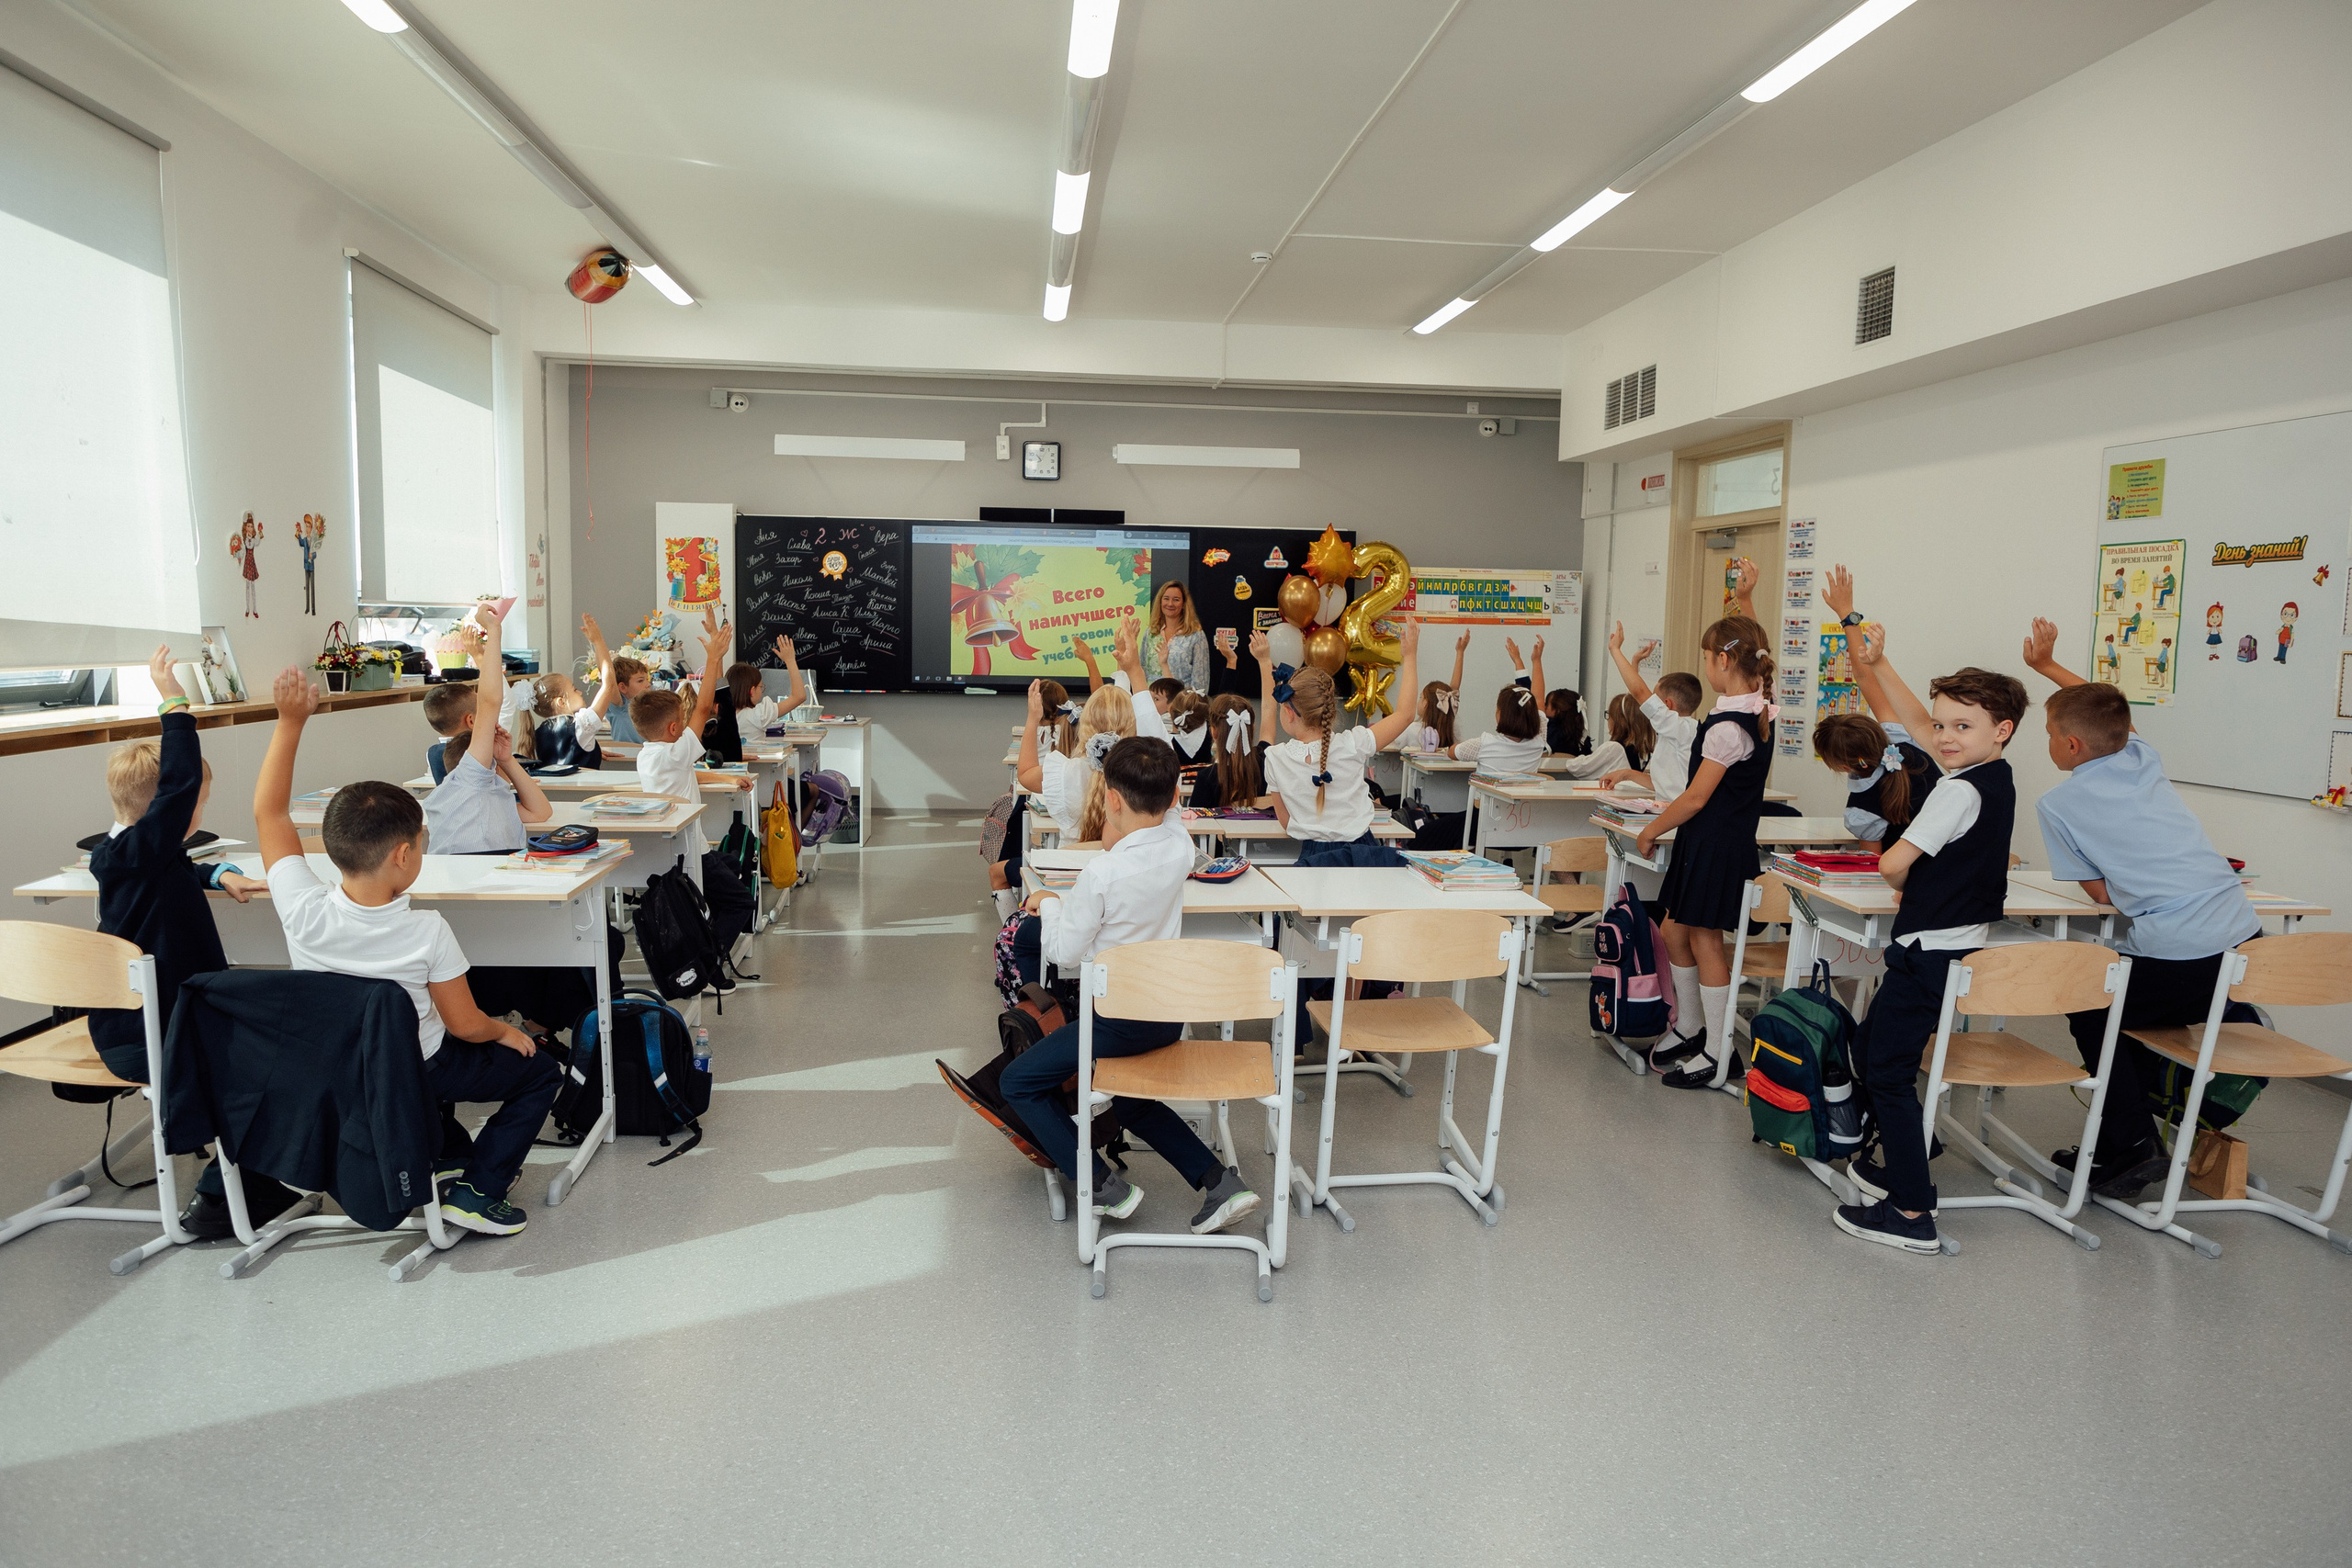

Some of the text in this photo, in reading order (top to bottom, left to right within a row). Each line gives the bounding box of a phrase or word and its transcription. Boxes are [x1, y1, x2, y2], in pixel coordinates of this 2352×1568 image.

[754, 528, 777, 545] Аня
[786, 537, 813, 550] Слава
[814, 527, 827, 545] 2
[874, 529, 899, 547] Вера
[2107, 544, 2179, 555] ПРАВИЛЬНАЯ ПОСАДКА
[2212, 535, 2308, 568] День знаний!
[775, 553, 802, 566] Захар
[2120, 556, 2141, 564] ВРЕМЯ
[2142, 554, 2173, 563] ЗАНЯТИЙ
[753, 570, 774, 586] Вова
[782, 575, 813, 587] Николь
[860, 567, 898, 588] Матвей
[773, 592, 808, 611] Настя
[1052, 587, 1105, 604] Всего
[811, 606, 839, 618] Алиса
[854, 607, 879, 618] Илья
[866, 597, 896, 612] Катя
[761, 609, 794, 622] Даня
[1029, 604, 1136, 631] наилучшего
[831, 620, 861, 634] Саша
[866, 617, 900, 635] Марго
[816, 640, 841, 655] Алиса
[859, 634, 893, 650] Арина
[1060, 635, 1069, 644] в
[831, 655, 866, 677] Артём
[1505, 800, 1532, 832] 30
